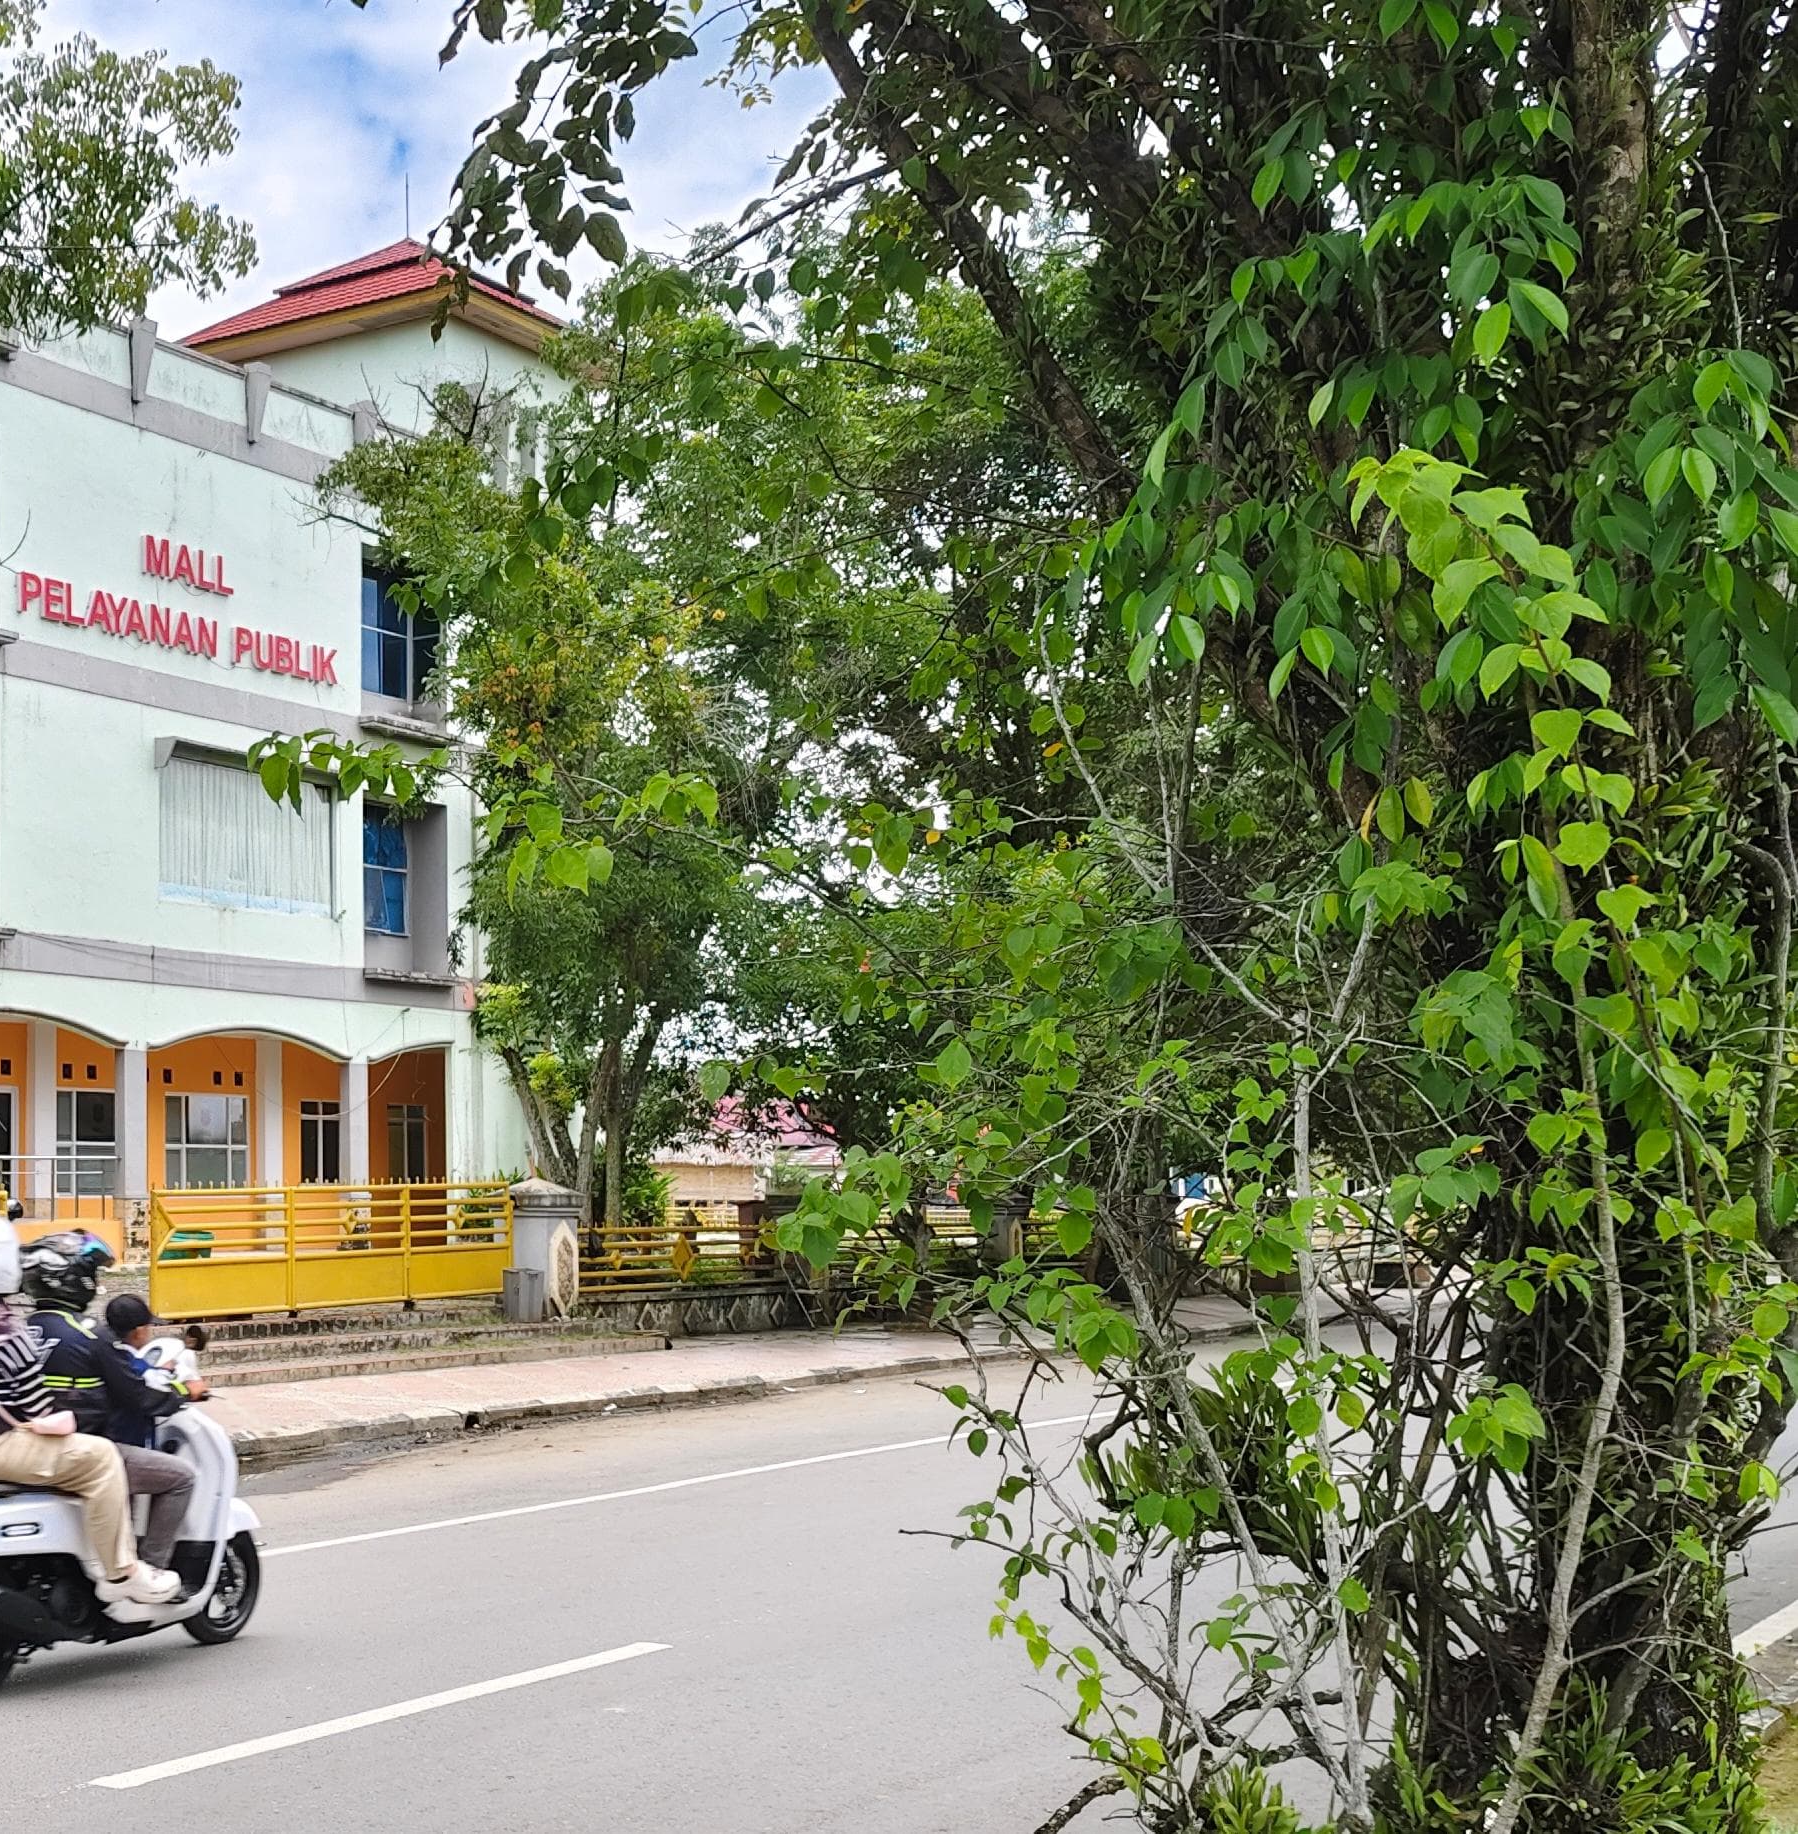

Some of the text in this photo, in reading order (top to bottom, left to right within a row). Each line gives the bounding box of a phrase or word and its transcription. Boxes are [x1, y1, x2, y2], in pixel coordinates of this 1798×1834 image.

[142, 534, 234, 596] MALL
[17, 571, 338, 685] PELAYANAN PUBLIK
